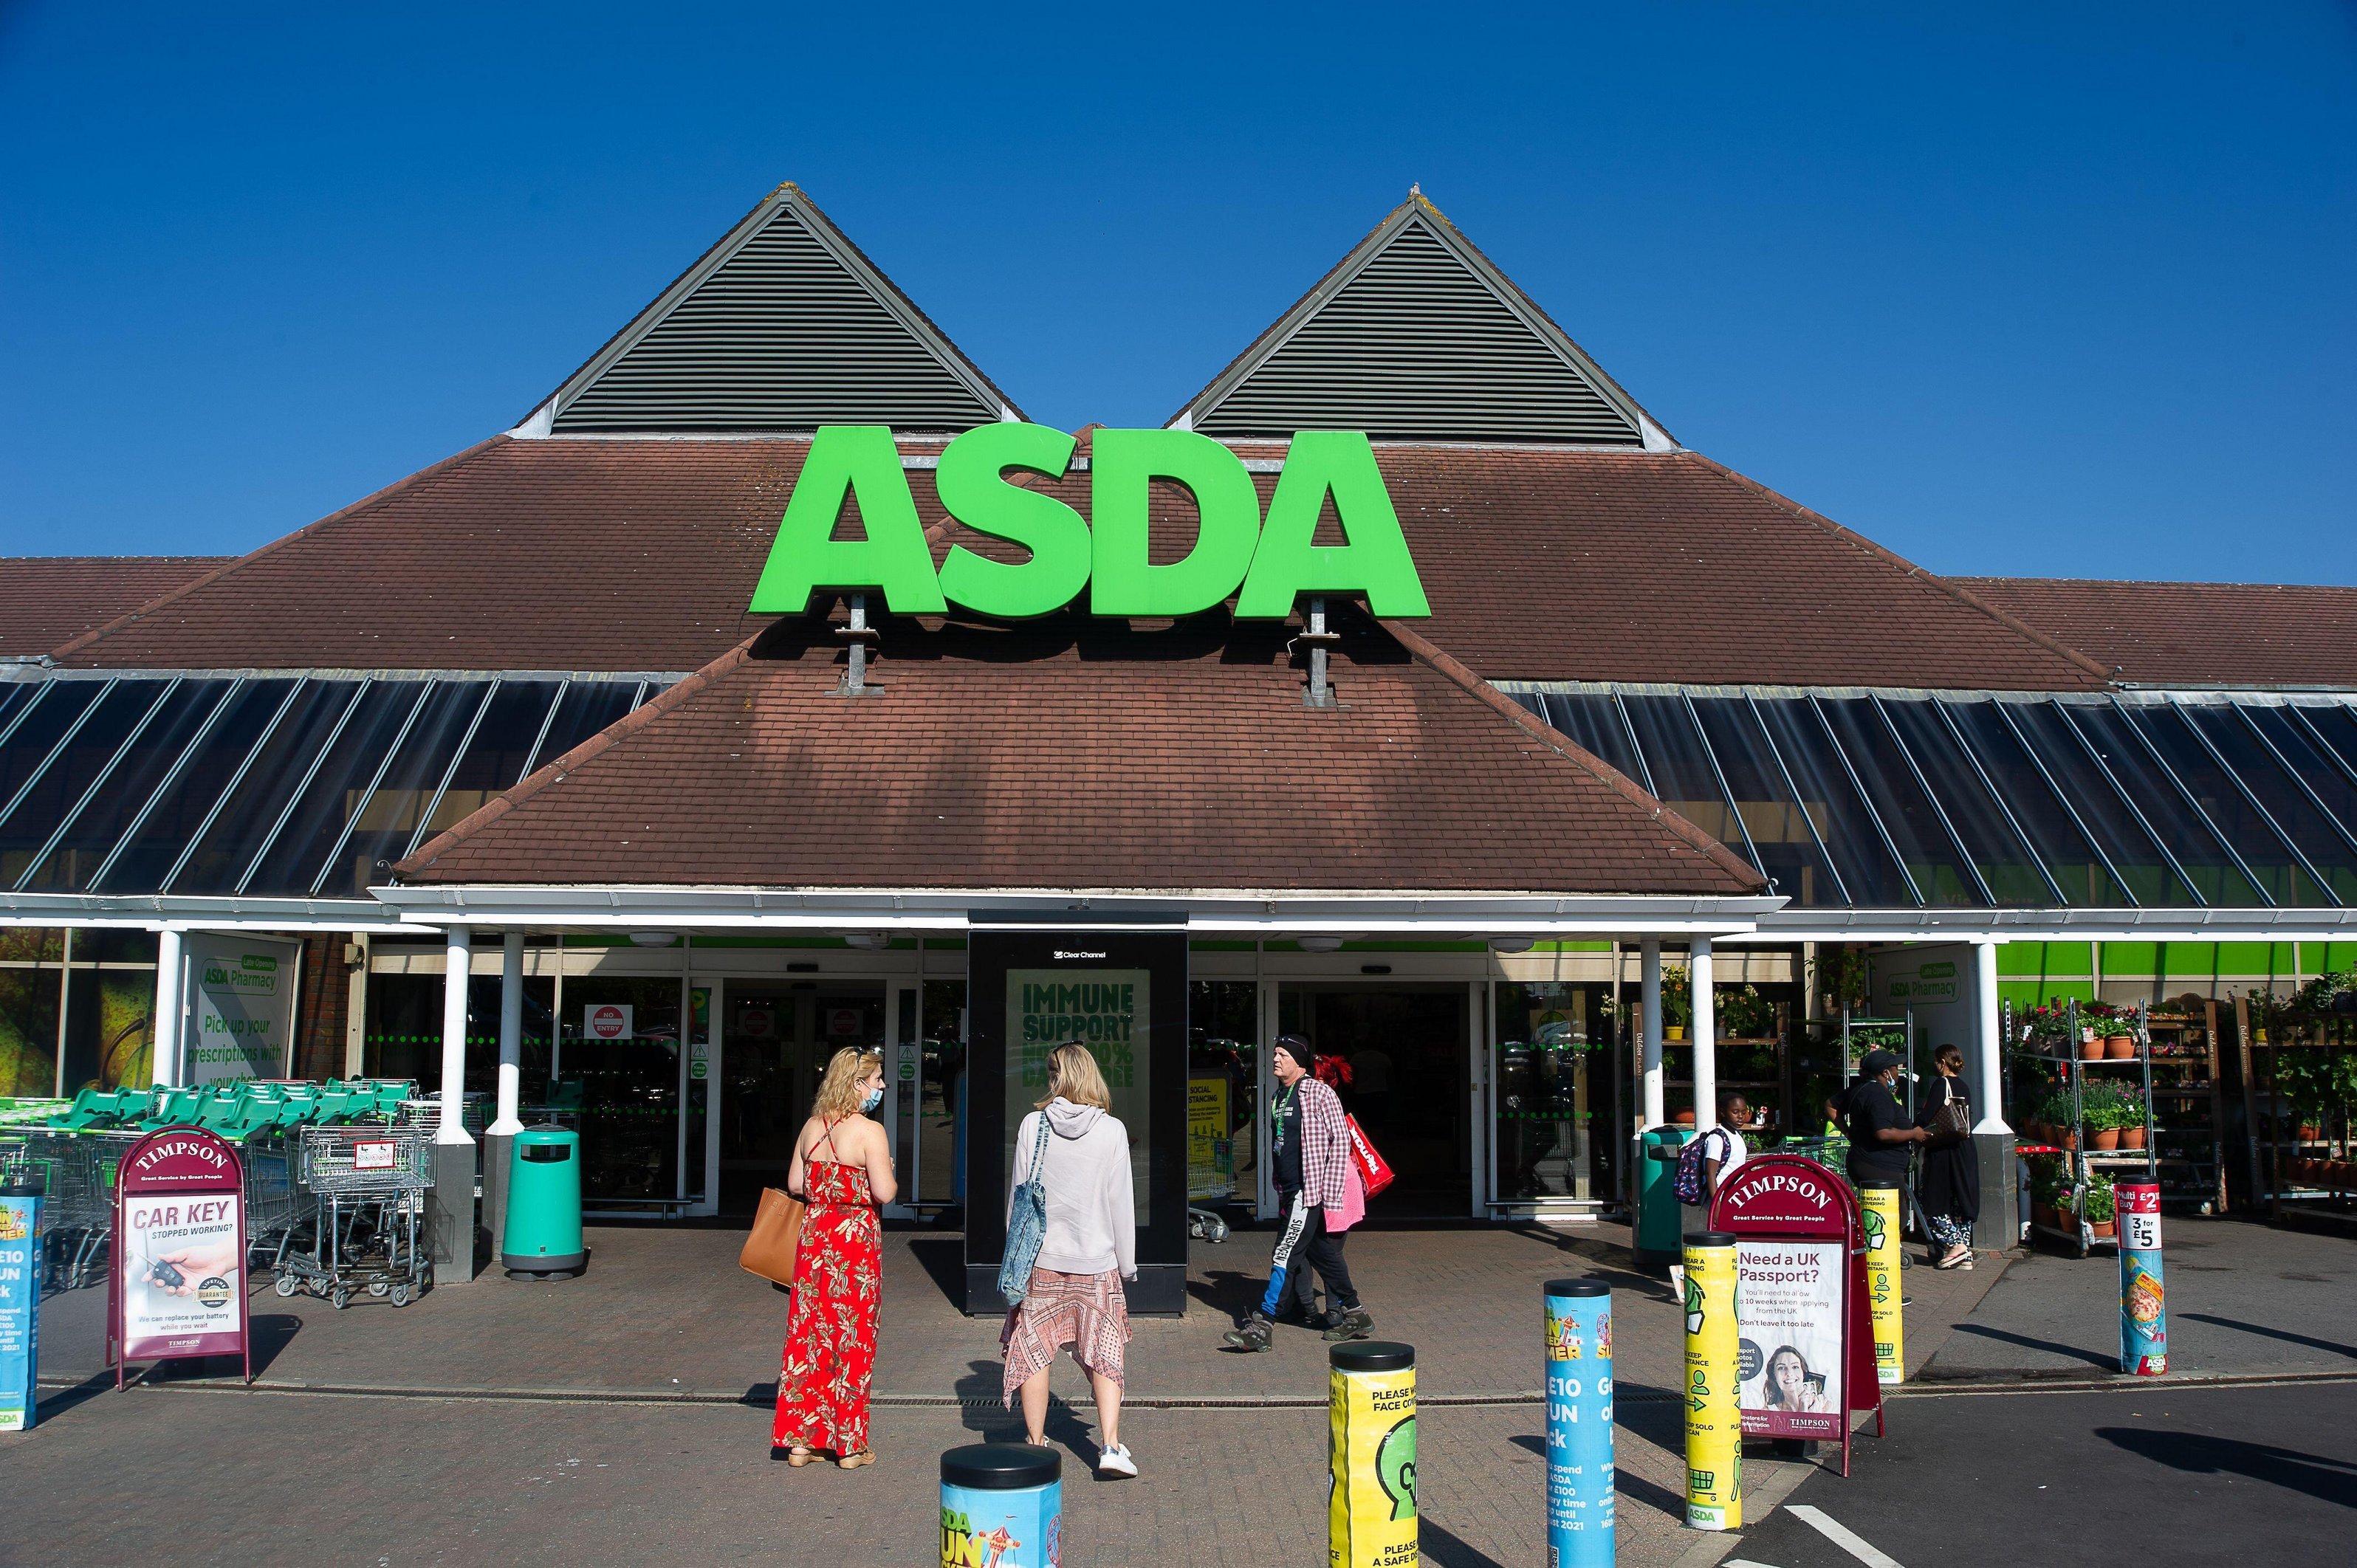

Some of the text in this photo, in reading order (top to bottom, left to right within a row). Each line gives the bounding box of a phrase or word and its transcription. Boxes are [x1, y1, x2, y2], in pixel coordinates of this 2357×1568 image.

[747, 422, 1433, 620] ASDA
[205, 968, 275, 991] ASDA Pharmacy
[1890, 980, 1956, 997] ASDA Pharmacy
[1023, 983, 1133, 1014] IMMUNE
[205, 1015, 270, 1036] Pick up your
[1022, 1015, 1133, 1041] SUPPORT
[188, 1042, 281, 1067] prescriptions with
[1086, 1042, 1133, 1065] 00%
[1190, 1085, 1211, 1094] SOCIAL
[1188, 1095, 1218, 1104] STANCING
[136, 1142, 228, 1171] TIMPSON
[1728, 1175, 1832, 1209] TIMPSON
[2117, 1191, 2135, 1200] Multi
[2119, 1200, 2134, 1209] Buy
[134, 1201, 229, 1229] CAR KEY
[2133, 1217, 2141, 1229] 3
[152, 1223, 233, 1239] STOPPED WORKING?
[2133, 1230, 2152, 1247] £5
[1740, 1252, 1781, 1265] Need
[1785, 1256, 1793, 1265] a
[1797, 1253, 1820, 1265] UK
[0, 1268, 21, 1280] UN
[1740, 1268, 1819, 1285] Passport?
[202, 1279, 226, 1289] LIFETIME
[1800, 1300, 1829, 1308] applying
[1548, 1345, 1582, 1361] MER
[1372, 1387, 1410, 1400] PLEASE
[1548, 1376, 1582, 1397] £10
[1373, 1401, 1401, 1411] FACE
[1549, 1403, 1579, 1423] UN
[0, 1414, 18, 1423] SDA
[1790, 1418, 1830, 1427] TIMPSON
[1550, 1428, 1567, 1448] ck
[1554, 1465, 1582, 1475] spend
[1549, 1474, 1571, 1485] ASDA
[1554, 1486, 1576, 1496] £100
[1563, 1499, 1586, 1508] time
[941, 1506, 972, 1534] SDA
[1556, 1509, 1576, 1519] until
[1689, 1508, 1715, 1522] ASDA
[1561, 1521, 1584, 1530] 2021
[940, 1526, 983, 1568] UN
[1385, 1540, 1416, 1555] PLEASE
[1372, 1558, 1381, 1567] A
[1385, 1555, 1410, 1566] SAFE
